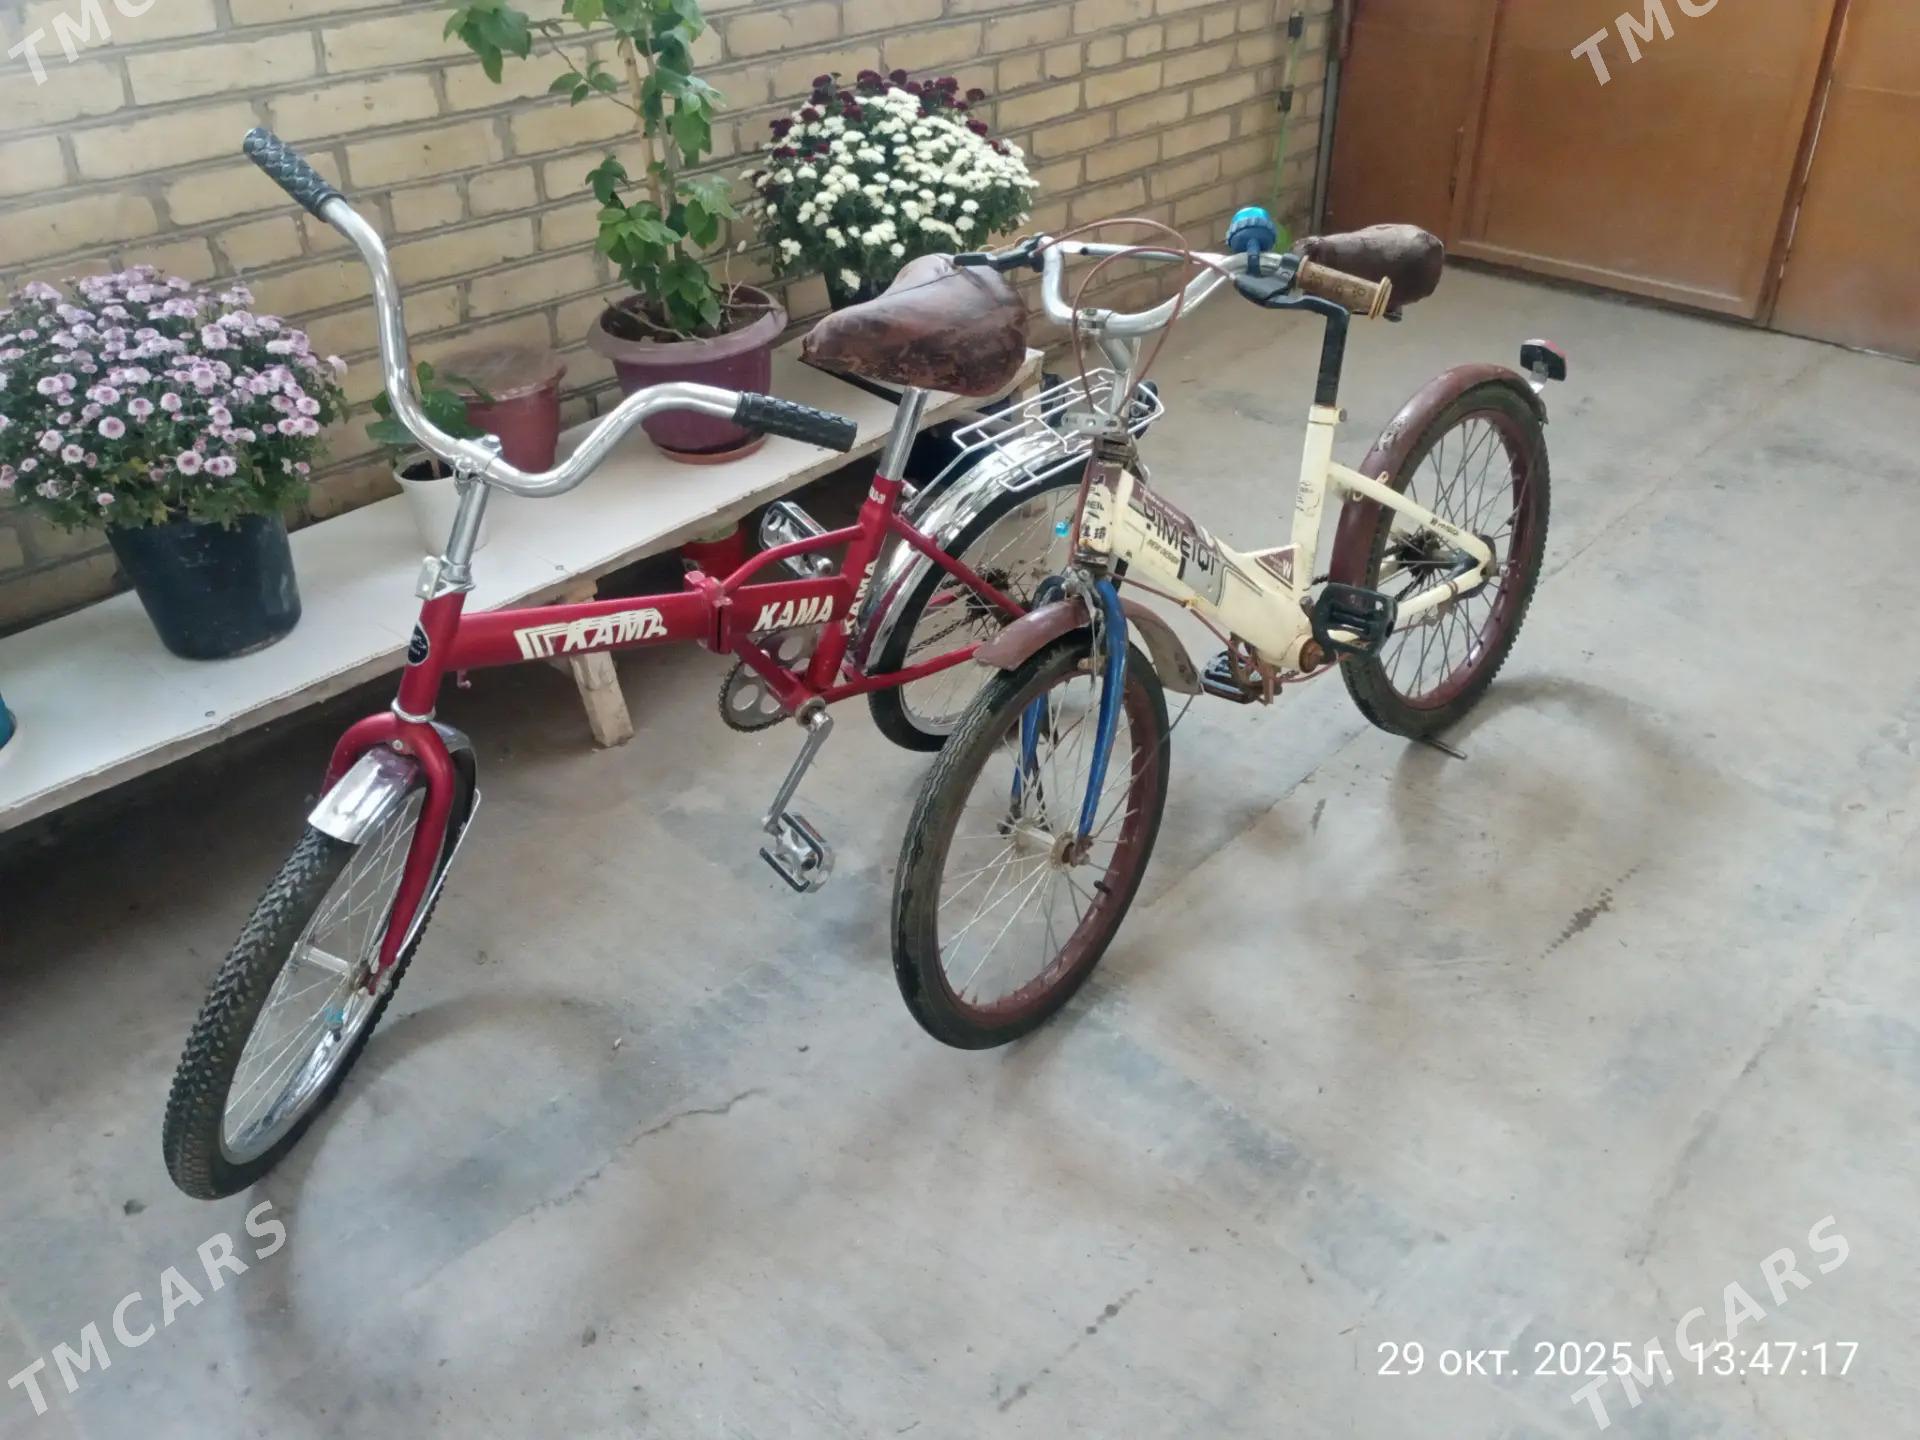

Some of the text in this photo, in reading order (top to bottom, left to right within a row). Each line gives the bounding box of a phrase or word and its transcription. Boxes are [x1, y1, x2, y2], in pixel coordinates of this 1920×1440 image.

[752, 595, 834, 632] KAMA
[842, 558, 879, 635] KAMA
[561, 607, 668, 652] KAMA
